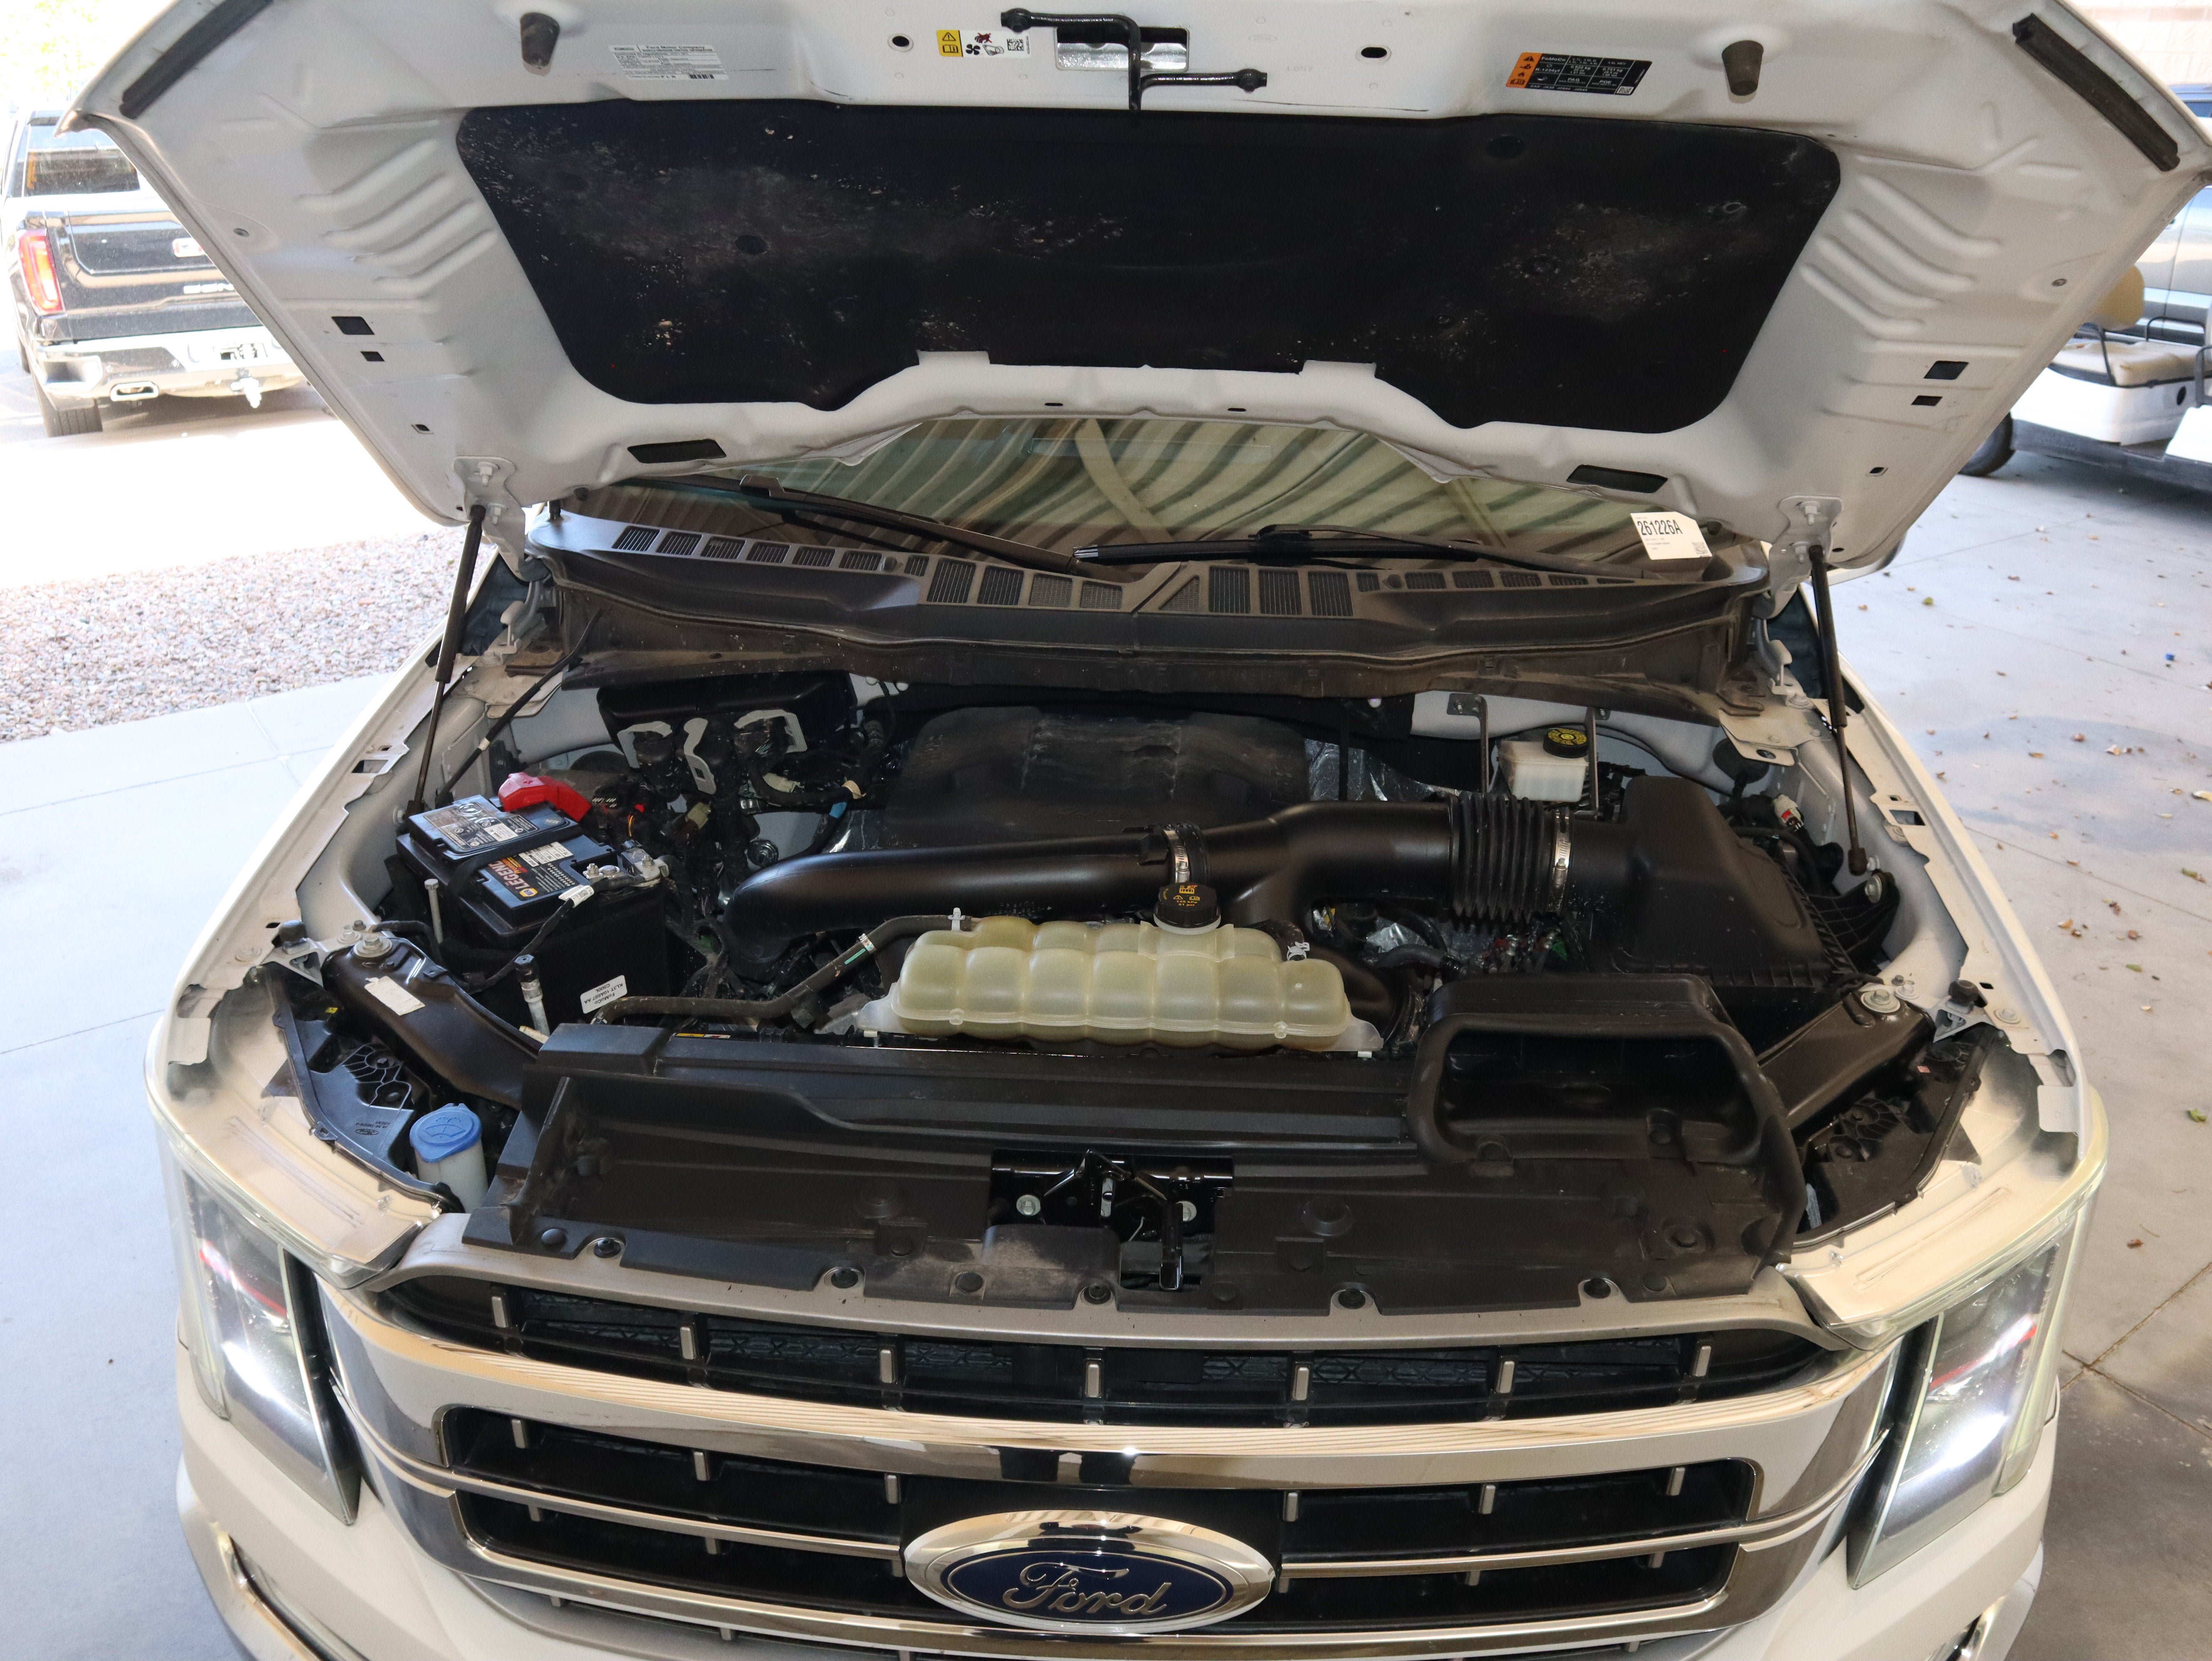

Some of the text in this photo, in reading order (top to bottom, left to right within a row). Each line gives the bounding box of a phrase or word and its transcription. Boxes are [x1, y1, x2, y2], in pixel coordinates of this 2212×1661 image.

[1637, 520, 1683, 536] 261226A
[488, 860, 530, 889] LEGEND
[595, 993, 615, 1004] FoMoCo
[1003, 1562, 1172, 1616] Ford
